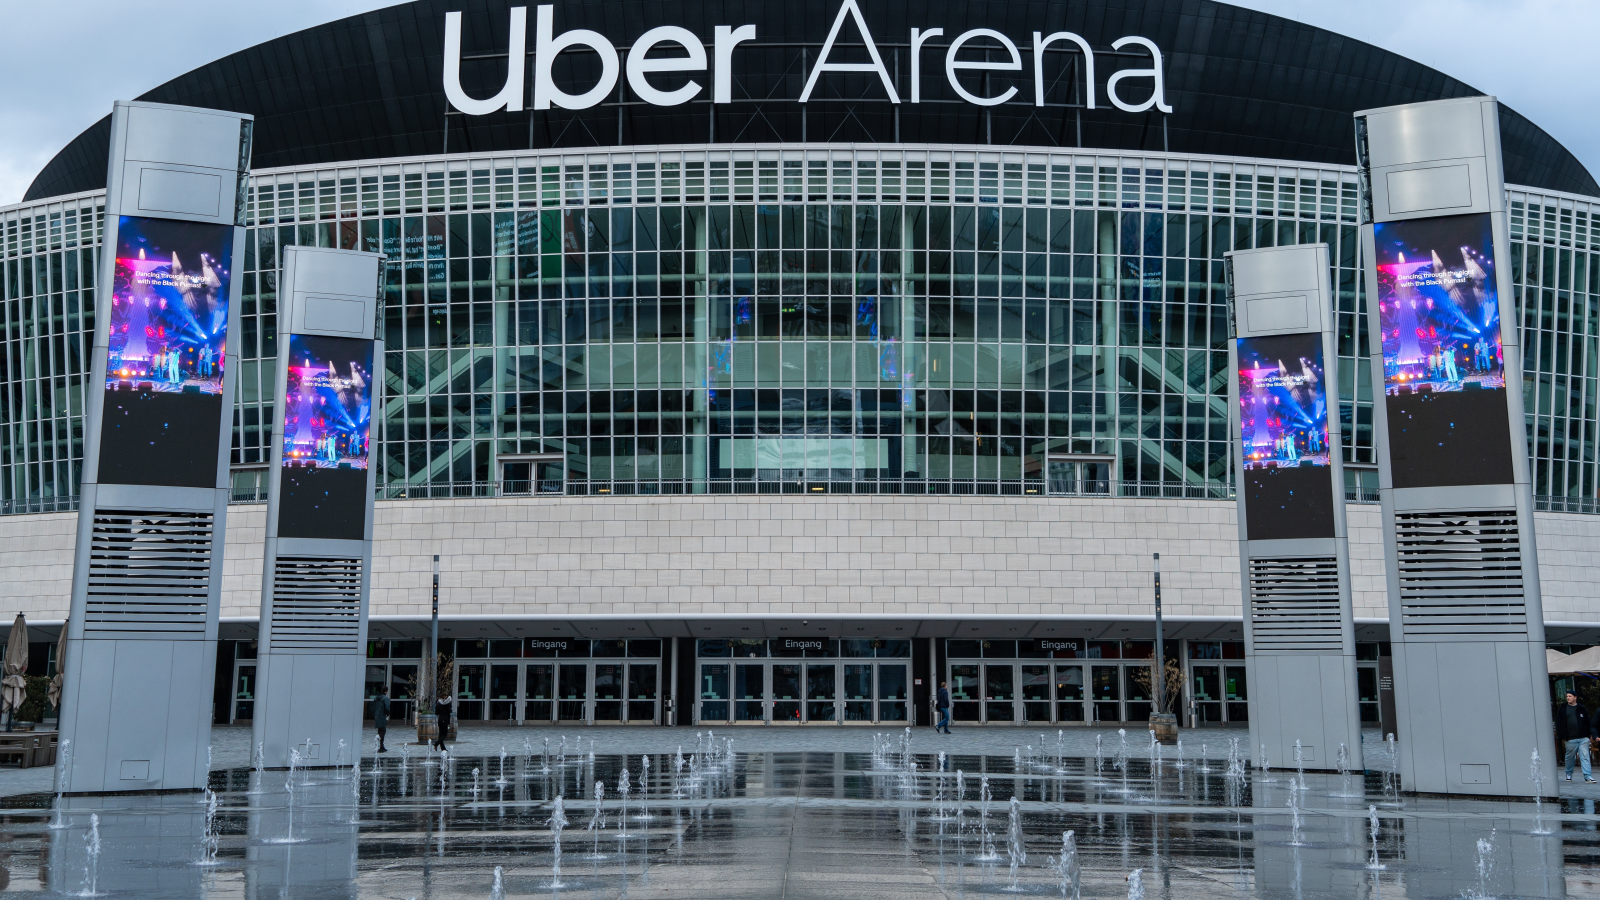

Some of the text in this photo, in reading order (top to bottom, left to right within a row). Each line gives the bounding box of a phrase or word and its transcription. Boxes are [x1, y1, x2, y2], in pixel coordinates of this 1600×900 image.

[443, 0, 1173, 116] Uber Arena
[531, 640, 566, 649] Eingang
[786, 640, 822, 649] Eingang
[1041, 641, 1077, 650] Eingang
